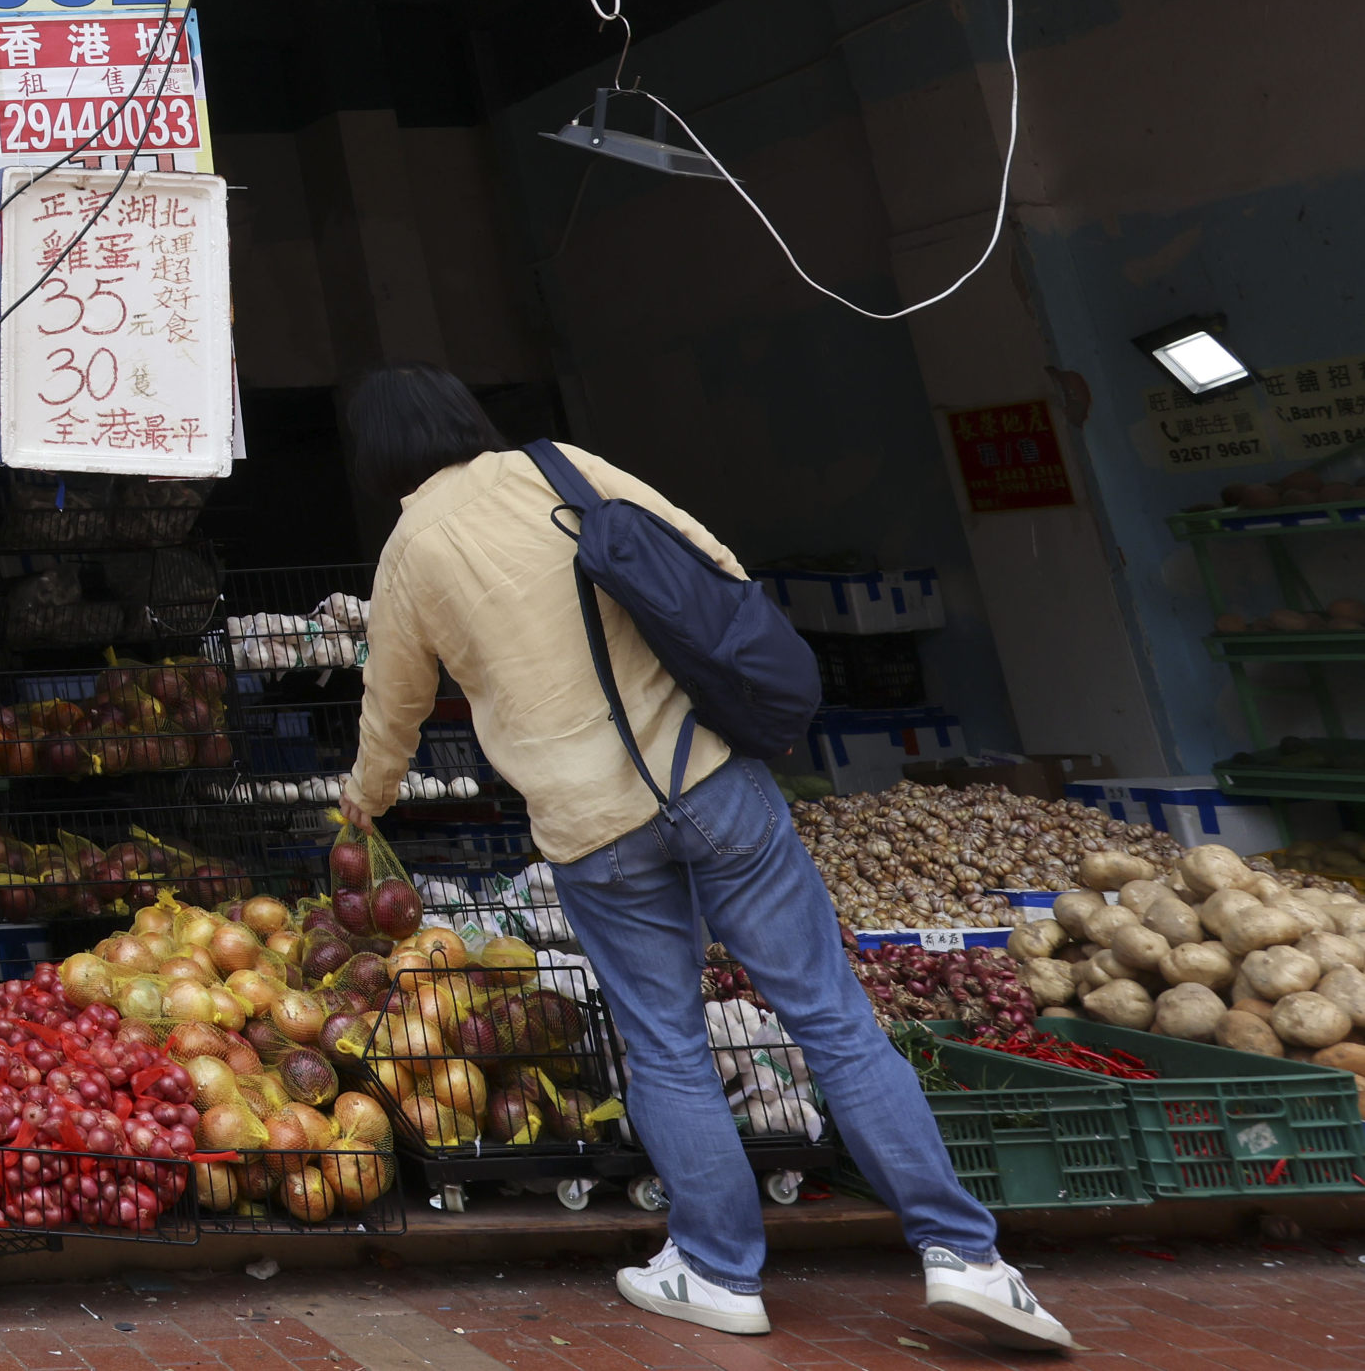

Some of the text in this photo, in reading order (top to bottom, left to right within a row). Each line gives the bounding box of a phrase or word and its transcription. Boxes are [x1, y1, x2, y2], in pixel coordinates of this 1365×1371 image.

[4, 99, 194, 150] 29440033
[33, 190, 195, 228] 正宗湖北
[38, 277, 126, 336] 35
[38, 348, 118, 405] 30
